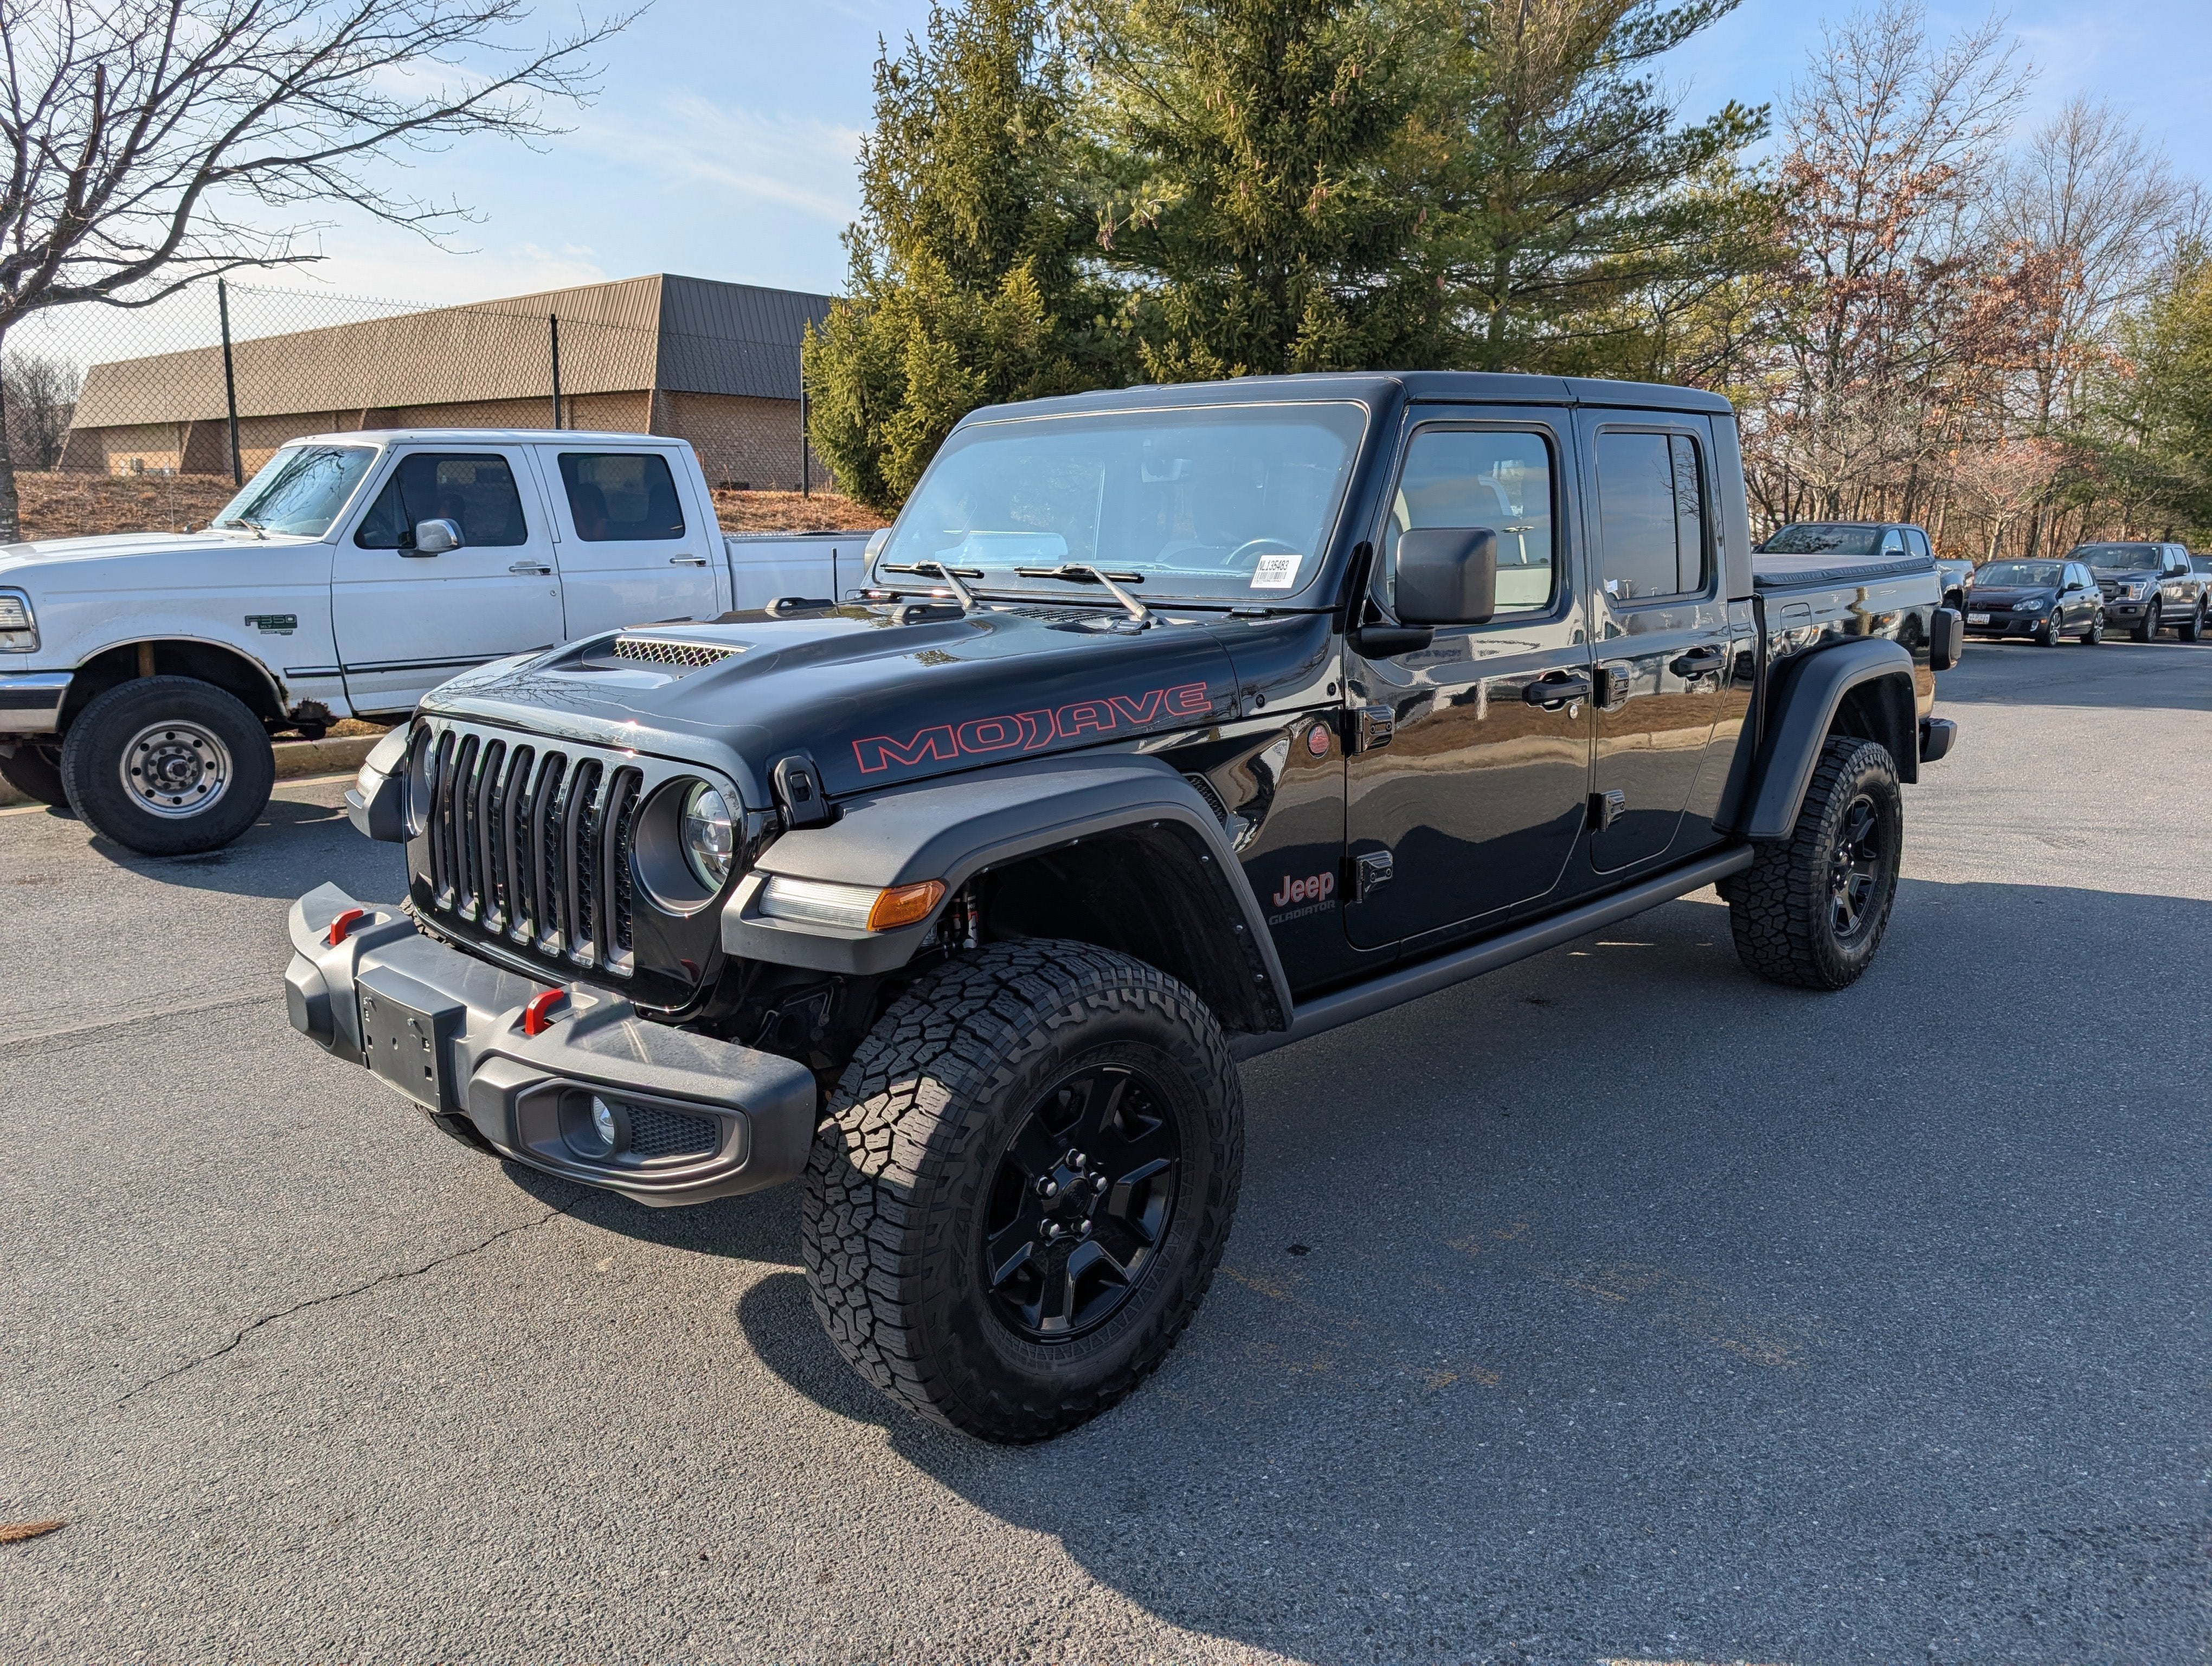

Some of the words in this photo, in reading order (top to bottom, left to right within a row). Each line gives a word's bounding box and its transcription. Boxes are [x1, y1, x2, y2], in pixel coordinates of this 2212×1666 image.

[851, 682, 1211, 773] MOJAVE
[1274, 872, 1334, 907] Jeep
[1269, 900, 1335, 925] GLADIATOR
